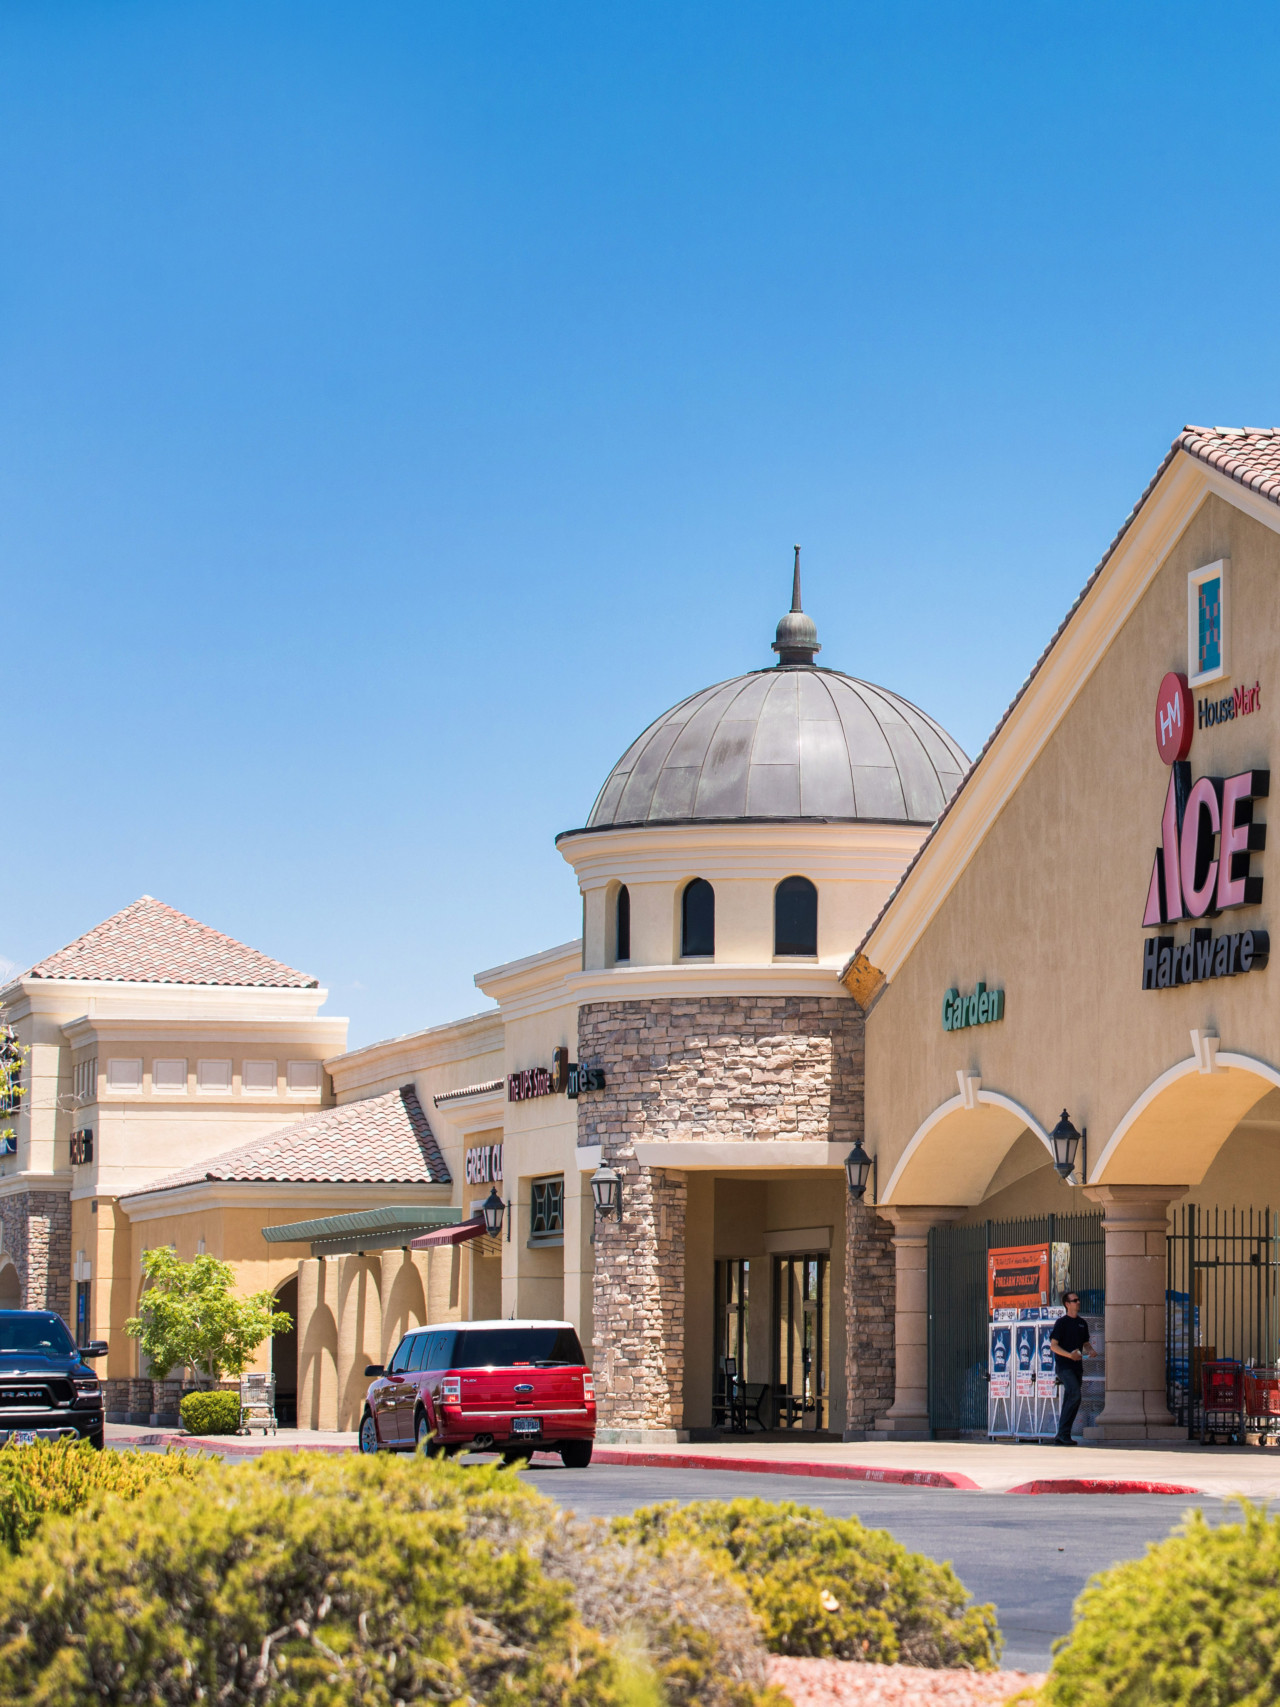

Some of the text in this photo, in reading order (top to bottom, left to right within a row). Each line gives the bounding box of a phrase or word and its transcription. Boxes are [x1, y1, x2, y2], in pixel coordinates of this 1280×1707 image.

[1159, 691, 1181, 746] HM
[1198, 680, 1261, 730] HouseMart
[1142, 762, 1264, 928] ACE
[1142, 928, 1267, 990] Hardware
[942, 982, 1004, 1032] Garden
[520, 1069, 533, 1100] UPS
[533, 1067, 551, 1097] Store
[466, 1146, 490, 1184] GREAT
